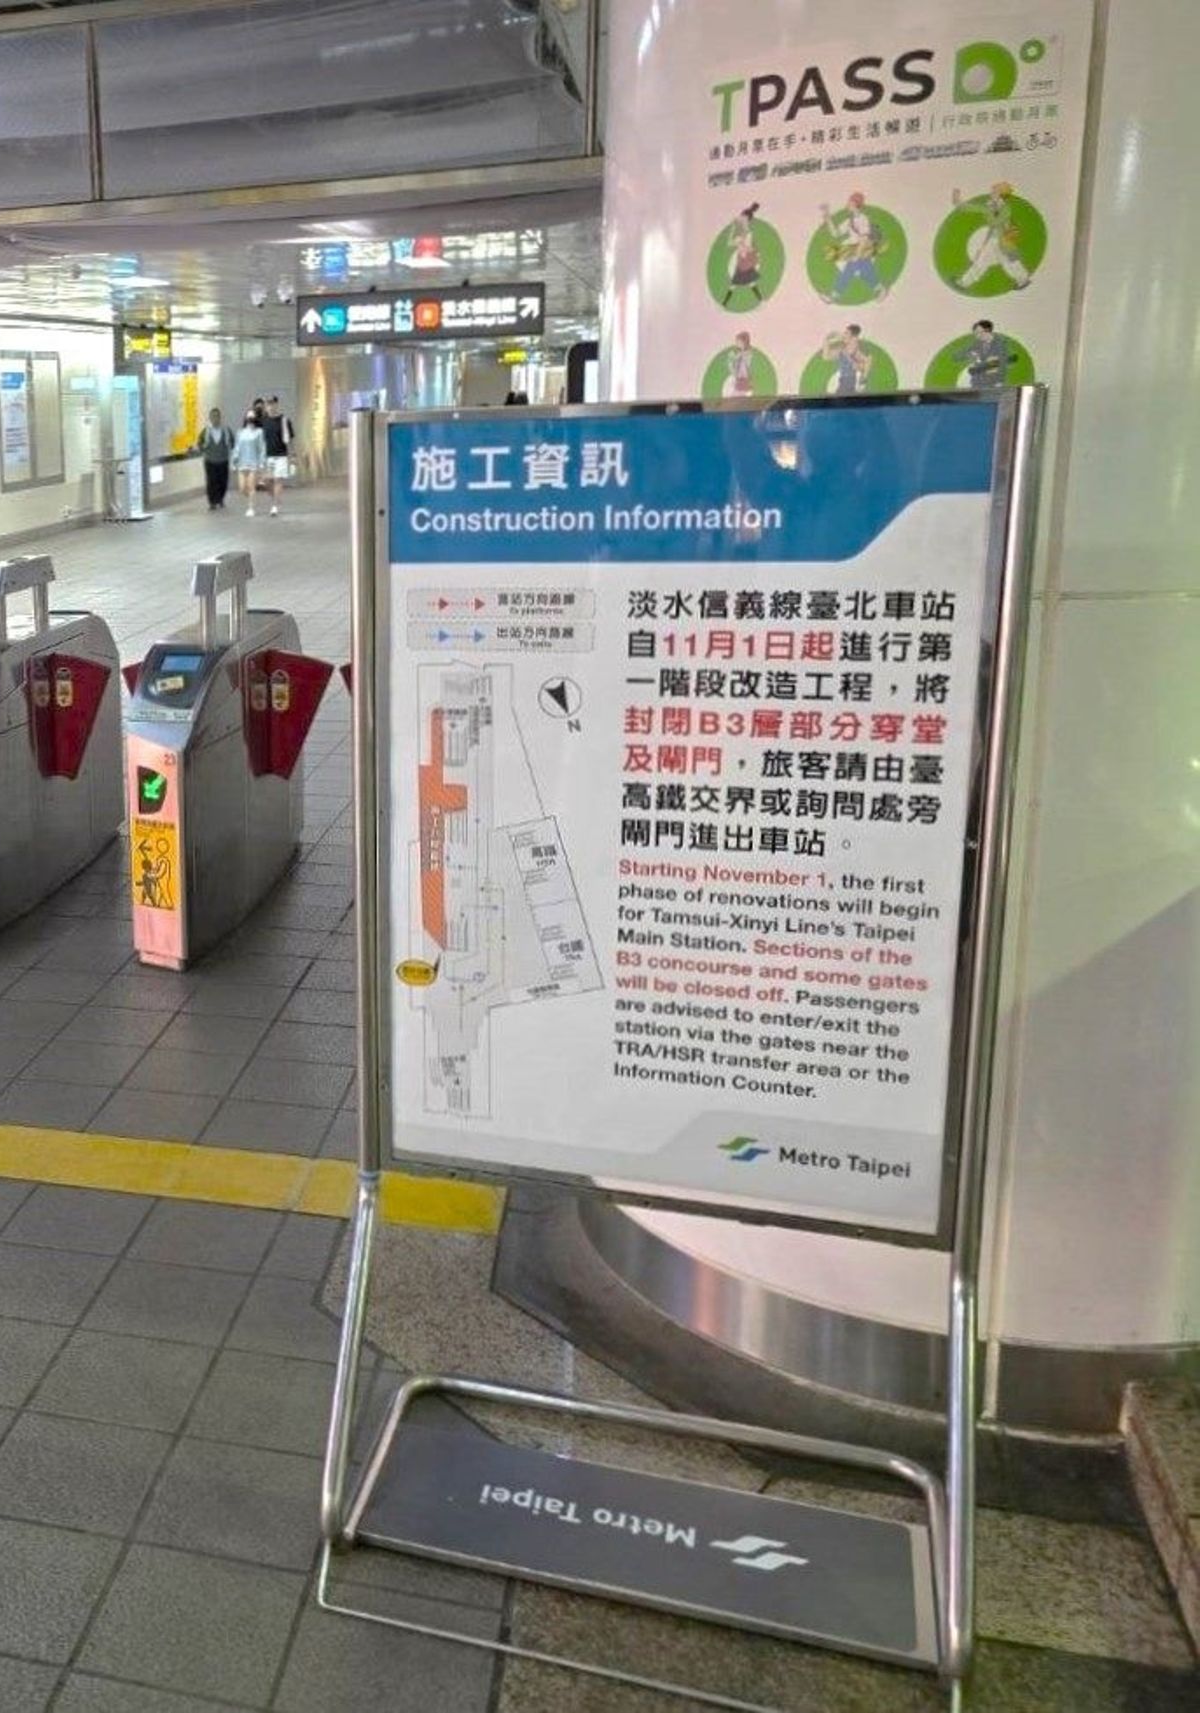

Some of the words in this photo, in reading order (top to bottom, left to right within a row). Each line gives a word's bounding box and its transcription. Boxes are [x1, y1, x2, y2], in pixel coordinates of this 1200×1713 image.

[712, 49, 936, 134] TPASS
[410, 440, 629, 492] 施工資訊
[410, 505, 595, 533] Construction
[604, 503, 783, 531] Information
[627, 589, 956, 622] 淡水信義線臺北車站
[627, 630, 953, 663] 自11月1日起進行第
[625, 668, 951, 704] 一階段改造工程，將
[567, 719, 582, 734] N
[623, 705, 948, 745] 封閉B3層部分穿堂
[622, 743, 945, 785] 及閘門，旅客請由臺
[621, 782, 942, 825] 高鐵交界或詢問處旁
[618, 859, 698, 882] Starting
[703, 864, 809, 887] November
[817, 873, 834, 889] 1,
[842, 874, 875, 891] the
[882, 876, 925, 895] first
[618, 884, 677, 903] phase
[683, 888, 704, 903] of
[709, 892, 830, 913] renovations
[837, 898, 873, 915] will
[879, 902, 940, 921] begin
[618, 905, 645, 921] for
[651, 907, 779, 935] Tamsui-Xinyi
[785, 918, 846, 938] Line's
[852, 922, 915, 943] Taipei
[617, 928, 664, 946] Main
[670, 933, 747, 954] Station.
[753, 938, 844, 961] Sections
[850, 946, 873, 963] of
[879, 949, 913, 966] the
[617, 951, 642, 967] B3
[647, 955, 753, 977] concourse
[759, 962, 798, 980] and
[803, 971, 862, 987] some
[868, 974, 929, 993] gates
[615, 976, 648, 991] will
[653, 978, 678, 994] be
[684, 981, 751, 1000] closed
[756, 987, 789, 1005] off.
[796, 990, 921, 1016] Passengers
[615, 999, 646, 1013] are
[651, 1001, 728, 1021] advised
[733, 1007, 754, 1024] to
[760, 1011, 860, 1035] enter/exit
[866, 1019, 900, 1037] the
[615, 1020, 681, 1039] station
[687, 1025, 715, 1042] via
[721, 1029, 753, 1046] the
[759, 1034, 817, 1053] gates
[822, 1041, 869, 1058] near
[875, 1043, 910, 1062] the
[614, 1040, 706, 1063] TRA/HSR
[711, 1051, 788, 1072] transfer
[796, 1062, 842, 1078] area
[849, 1066, 871, 1081] or
[877, 1066, 911, 1085] the
[614, 1062, 726, 1089] Information
[732, 1074, 817, 1099] Counter.
[779, 1147, 841, 1170] Metro
[847, 1154, 912, 1179] Taipei
[479, 1484, 583, 1525] Taipei
[592, 1507, 697, 1549] Metro
